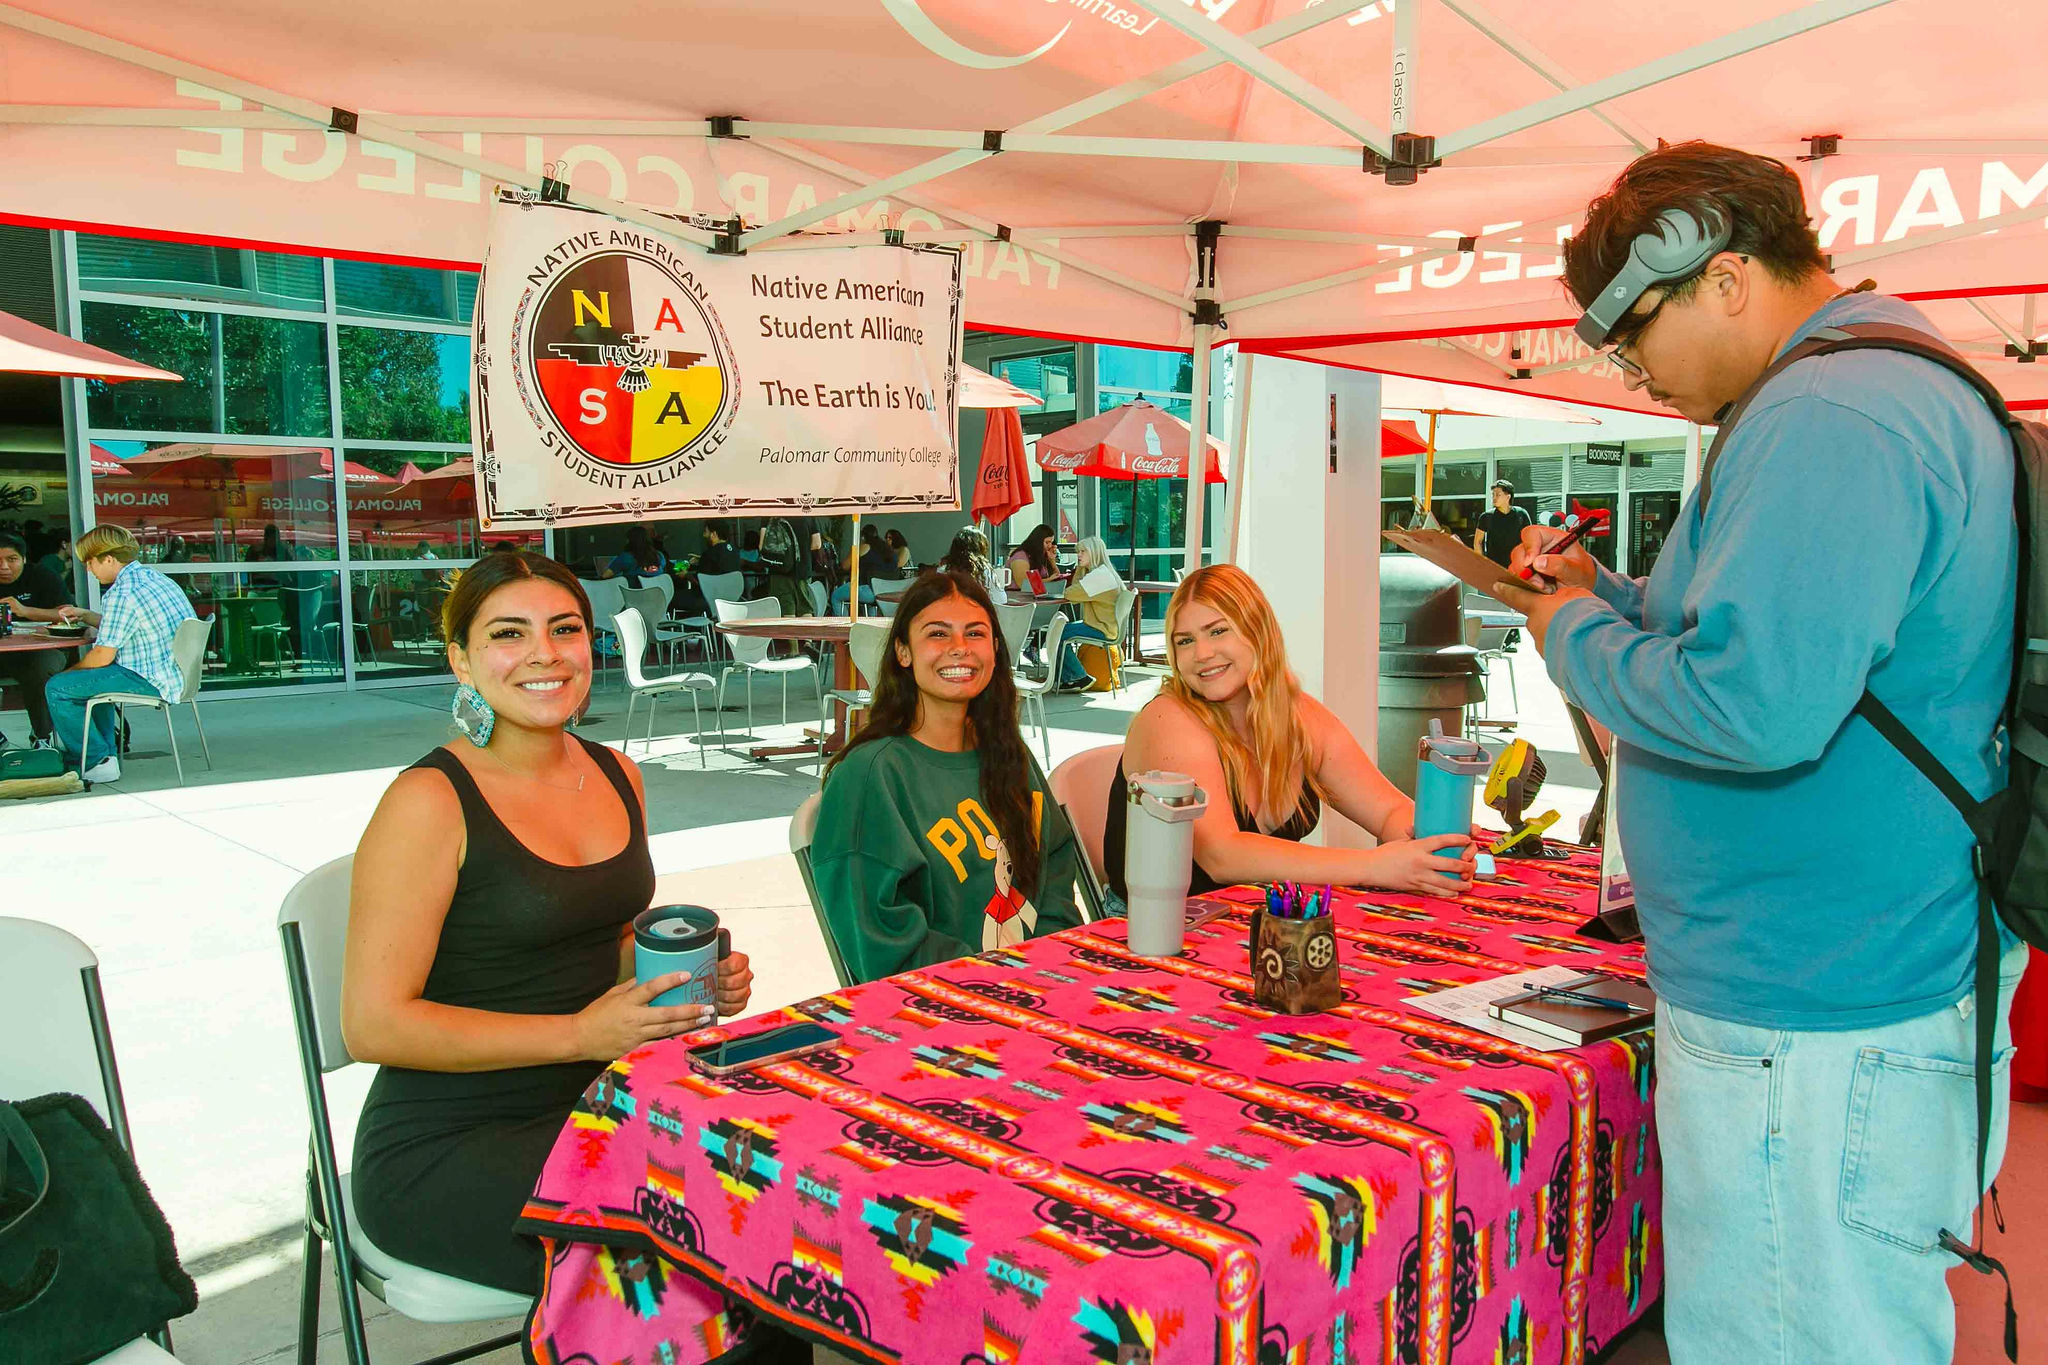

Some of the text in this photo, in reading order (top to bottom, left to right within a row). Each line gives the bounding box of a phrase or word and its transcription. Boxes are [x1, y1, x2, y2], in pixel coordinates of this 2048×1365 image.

[1393, 61, 1405, 121] classic
[527, 230, 709, 301] NATIVE AMERICAN
[751, 274, 924, 307] Native American
[571, 289, 685, 333] N A
[760, 314, 924, 345] Student Alliance
[579, 387, 691, 426] S A
[759, 380, 936, 412] The Earth is You!
[540, 430, 729, 490] STUDENT ALLIANCE
[759, 446, 942, 468] Palomar Community College
[1131, 455, 1182, 474] Coca-Cola
[1588, 448, 1621, 461] BOOKSTORE
